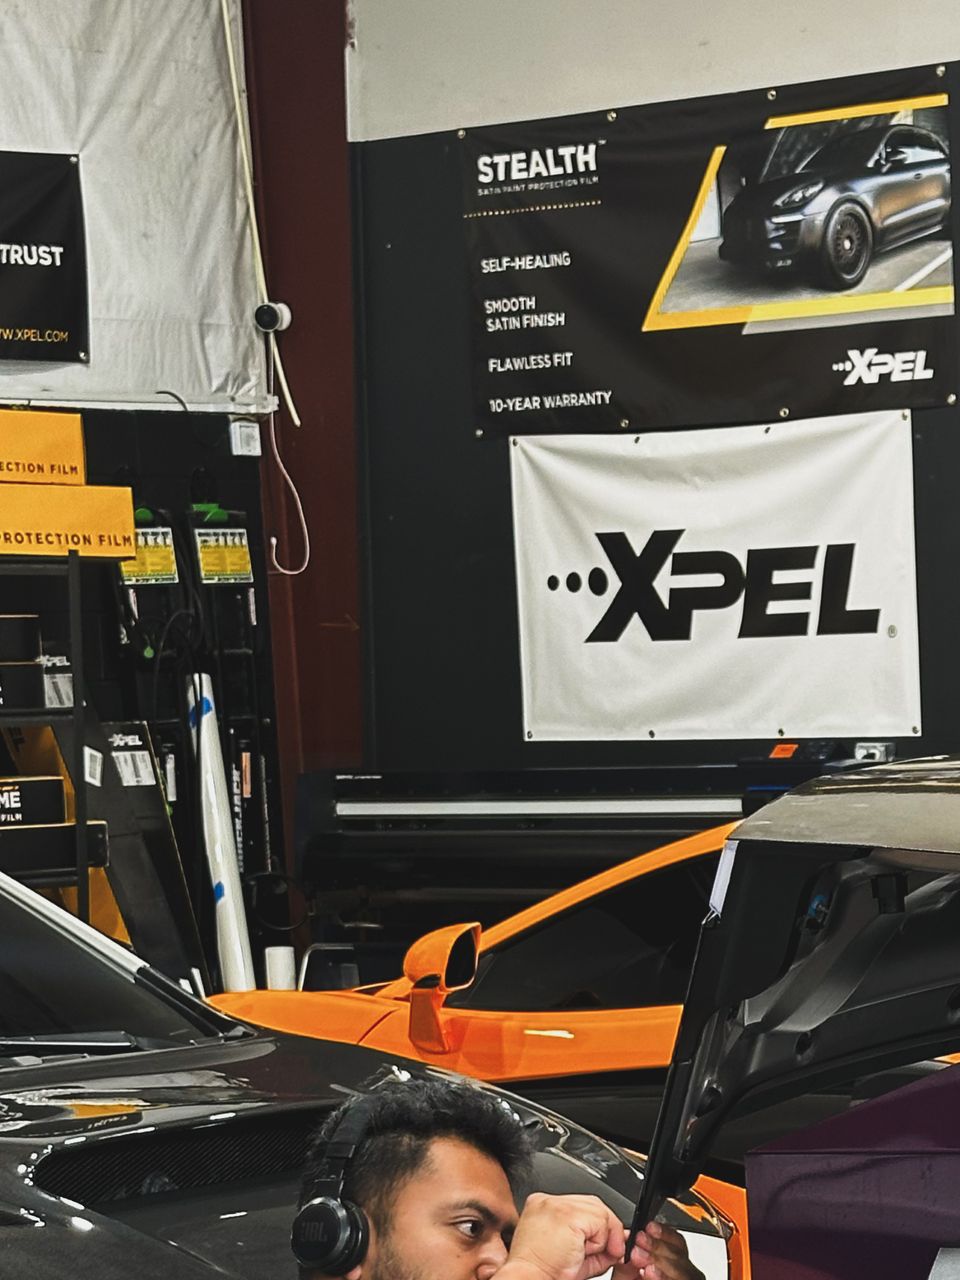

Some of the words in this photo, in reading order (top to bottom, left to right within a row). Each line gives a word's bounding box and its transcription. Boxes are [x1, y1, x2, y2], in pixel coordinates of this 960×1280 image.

[477, 144, 597, 184] STEALTH
[0, 243, 64, 267] TRUST
[480, 251, 572, 274] SELF-HEALING
[484, 296, 536, 314] SMOOTH
[486, 316, 521, 333] SATIN
[521, 312, 566, 329] FINISH
[488, 354, 552, 373] FLAWLESS
[552, 351, 574, 368] FIT
[843, 347, 934, 386] XPEL
[488, 395, 541, 413] 10-YEAR
[541, 390, 612, 409] WARRANTY
[50, 463, 79, 475] FILM
[0, 531, 92, 546] ROTECTION
[98, 534, 132, 547] FILM
[584, 528, 881, 644] XPEL
